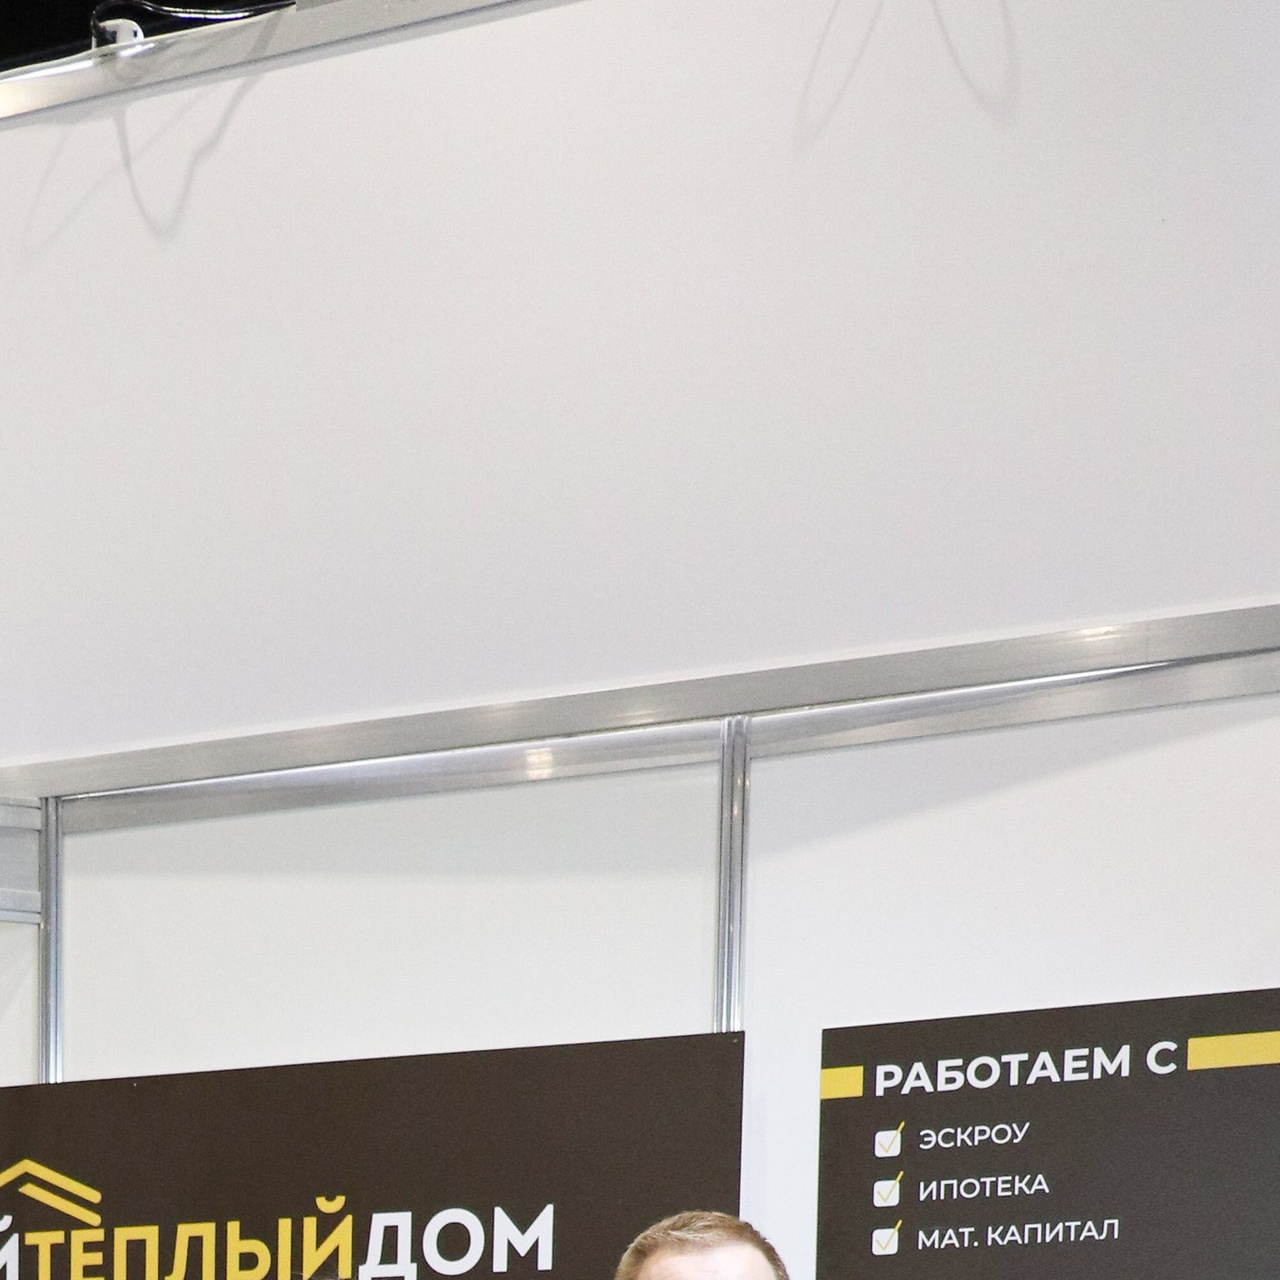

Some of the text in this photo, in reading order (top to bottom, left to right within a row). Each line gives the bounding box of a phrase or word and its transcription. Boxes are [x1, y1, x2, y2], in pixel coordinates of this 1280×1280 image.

[874, 1040, 1178, 1097] РАБОТАЕМ С
[919, 1122, 1031, 1150] ЭСКРОУ
[919, 1173, 1050, 1202] ИПОТЕКА
[918, 1218, 1120, 1250] МАТ. КАПИТАЛ
